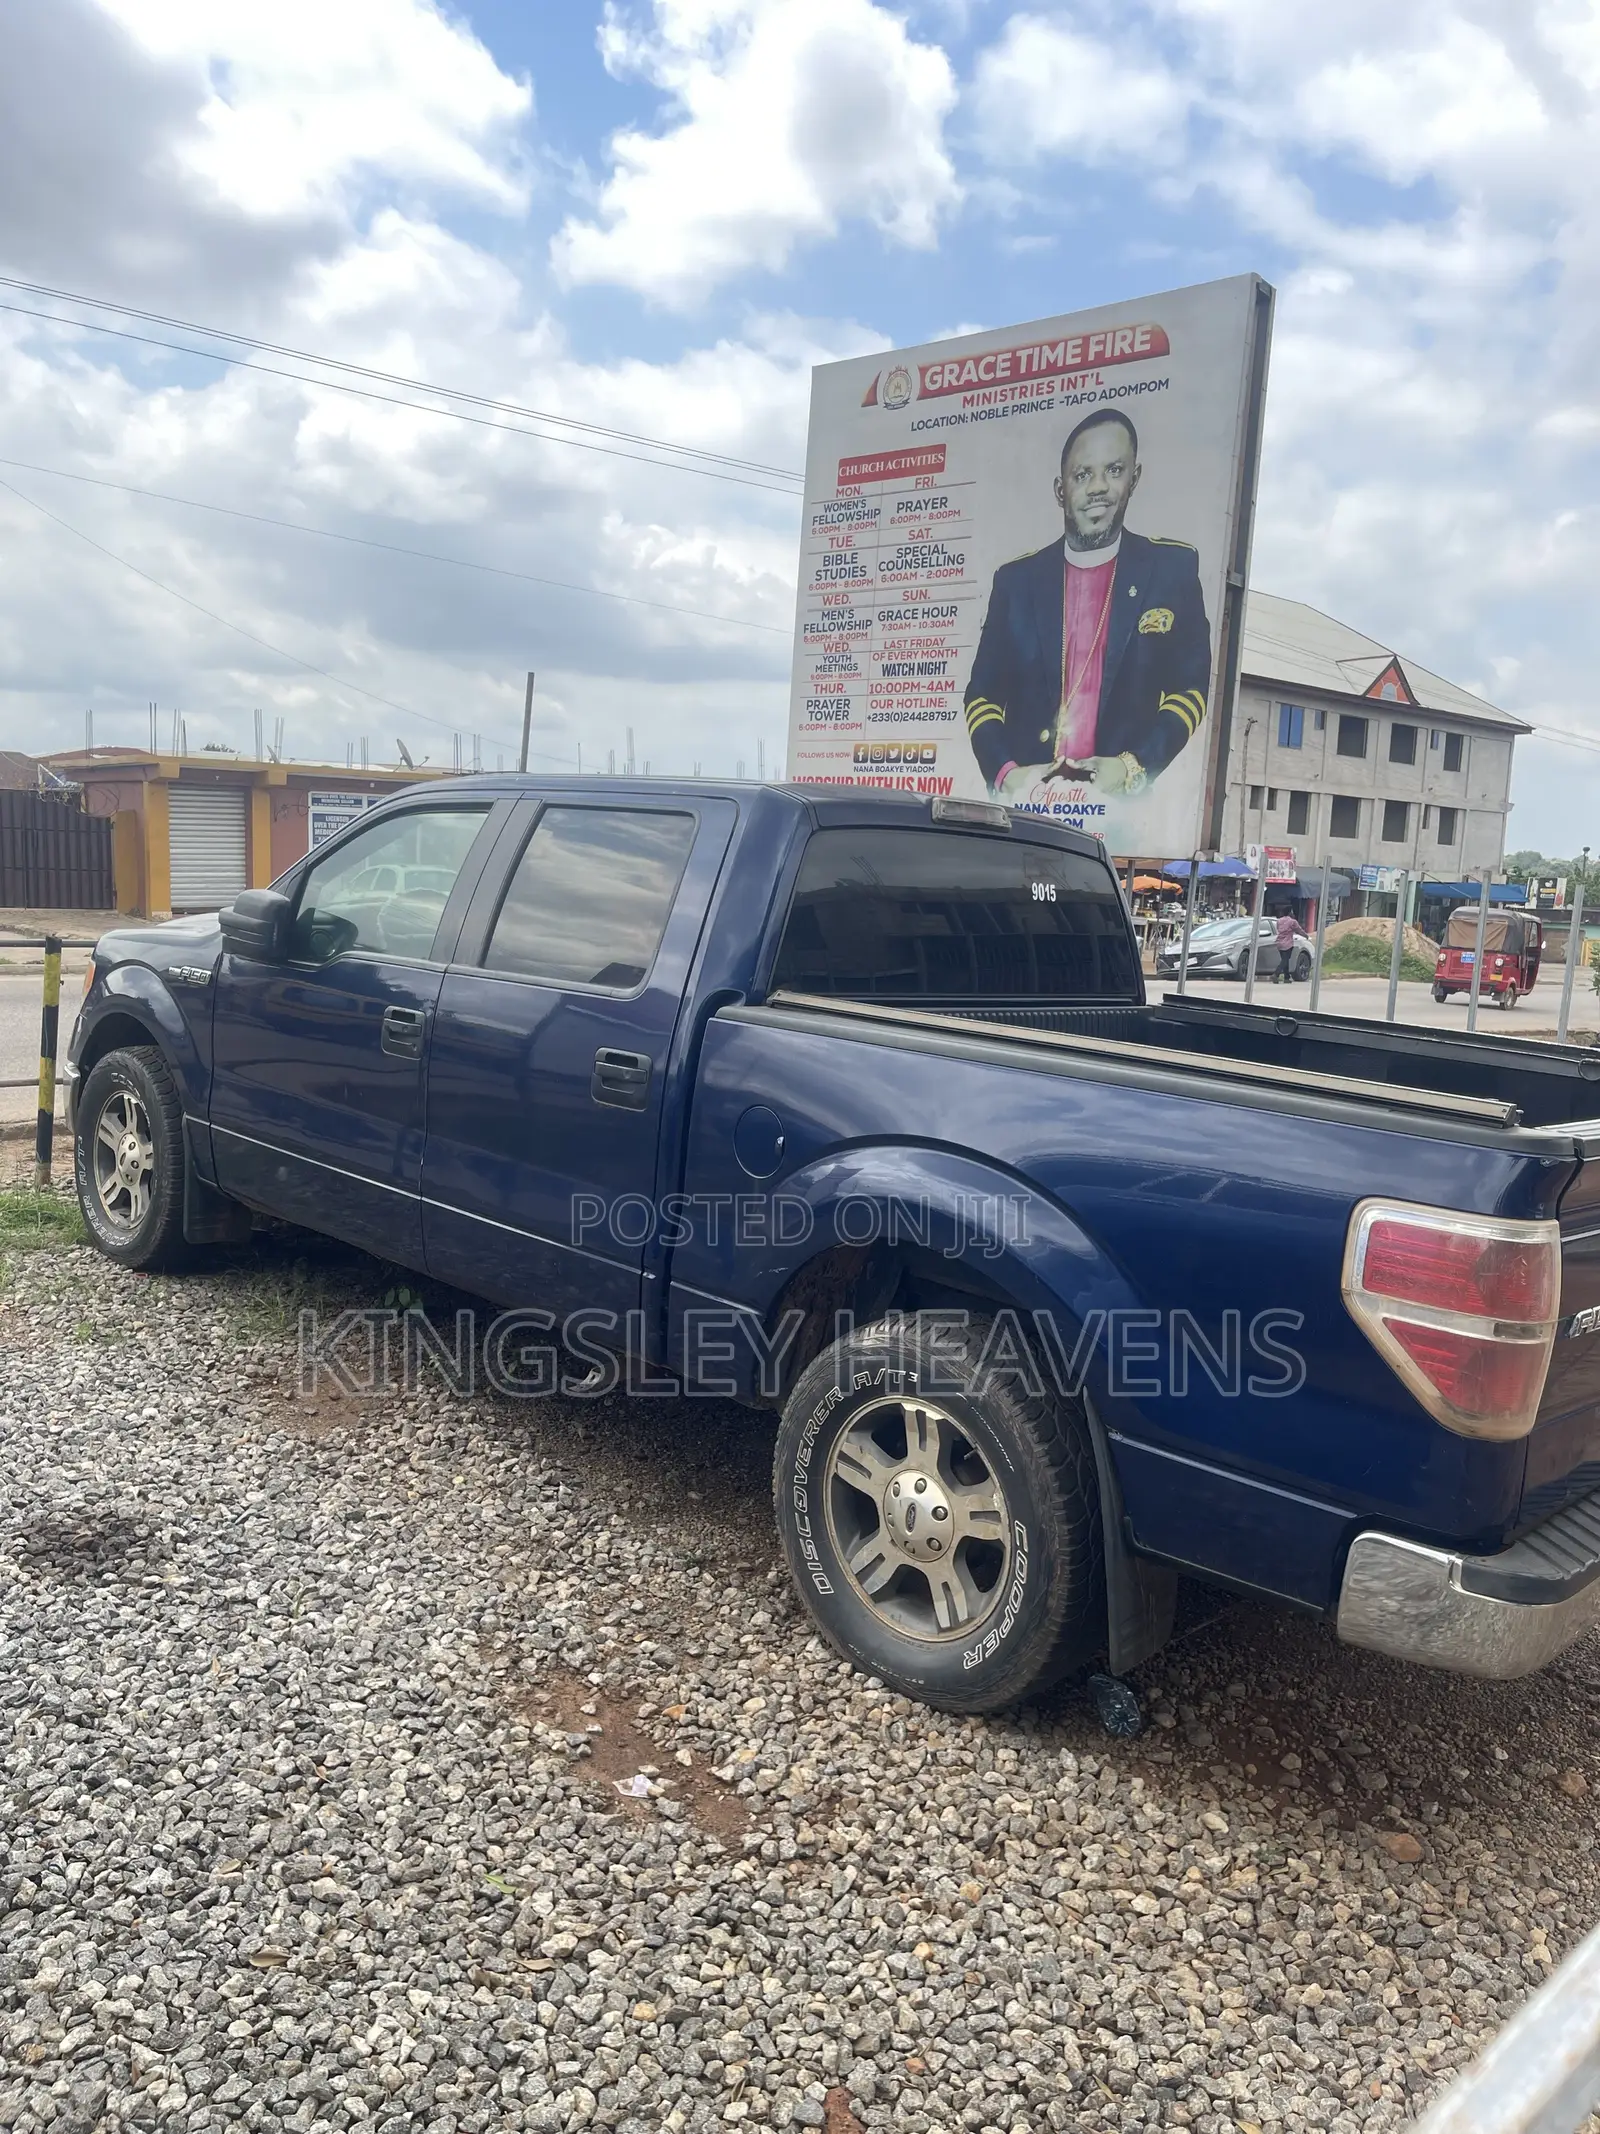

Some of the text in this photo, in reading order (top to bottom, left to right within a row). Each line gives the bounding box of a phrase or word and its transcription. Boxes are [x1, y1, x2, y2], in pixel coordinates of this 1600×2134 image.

[924, 354, 1010, 392] GRACE
[1016, 336, 1083, 372] TIME
[1088, 324, 1151, 361] FIRE
[962, 371, 1104, 408] MINISTRIES INT'L
[911, 411, 968, 432] LOCATION:
[970, 404, 1009, 423] NOBLE
[1011, 397, 1054, 417] PRINCE
[1099, 378, 1170, 400] ADOMPOM
[839, 452, 945, 477] CHURCH ACTIVITIES
[914, 476, 937, 489] FRI.
[835, 486, 863, 498] MON.
[824, 499, 867, 513] WOMEN'S
[896, 496, 948, 513] PRAYER
[812, 508, 881, 526] FELLOWSHIP
[890, 514, 921, 525] 6:00PM
[928, 509, 960, 520] 8:00PM
[908, 528, 933, 540] SAT.
[828, 535, 856, 549] TUE.
[896, 543, 948, 559] SPECIAL
[822, 552, 859, 567] BIBLE
[878, 553, 965, 572] COUNSELLING
[815, 565, 867, 581] STUDIES
[926, 567, 964, 579] 2:00PM
[822, 594, 851, 606] WED.
[902, 589, 931, 601] SUN.
[821, 609, 855, 621] MEN'S
[877, 605, 958, 622] GRACE HOUR
[803, 619, 873, 634] FELLOWSHIP
[881, 622, 911, 631] 7:30AM
[919, 619, 954, 629] 10:30AM
[823, 642, 851, 653] WED.
[884, 637, 946, 650] LAST FRIDAY
[822, 654, 852, 664] YOUTH
[872, 648, 958, 662] OF EVERY MONTH
[815, 662, 858, 673] MEETINGS
[882, 661, 947, 677] WATCH NIGHT
[814, 683, 846, 694] THUR.
[806, 699, 850, 710] PRAYER
[870, 697, 947, 709] OUR HOTLINE:
[808, 710, 849, 721] TOWER
[875, 765, 904, 773] BOAKYE
[917, 776, 953, 796] NOW
[1030, 782, 1088, 807] Apostle
[1053, 804, 1106, 815] BOAKYE
[1032, 882, 1056, 902] 9015
[793, 1385, 844, 1595] DISCOVERER
[963, 1520, 1028, 1670] COOPER
